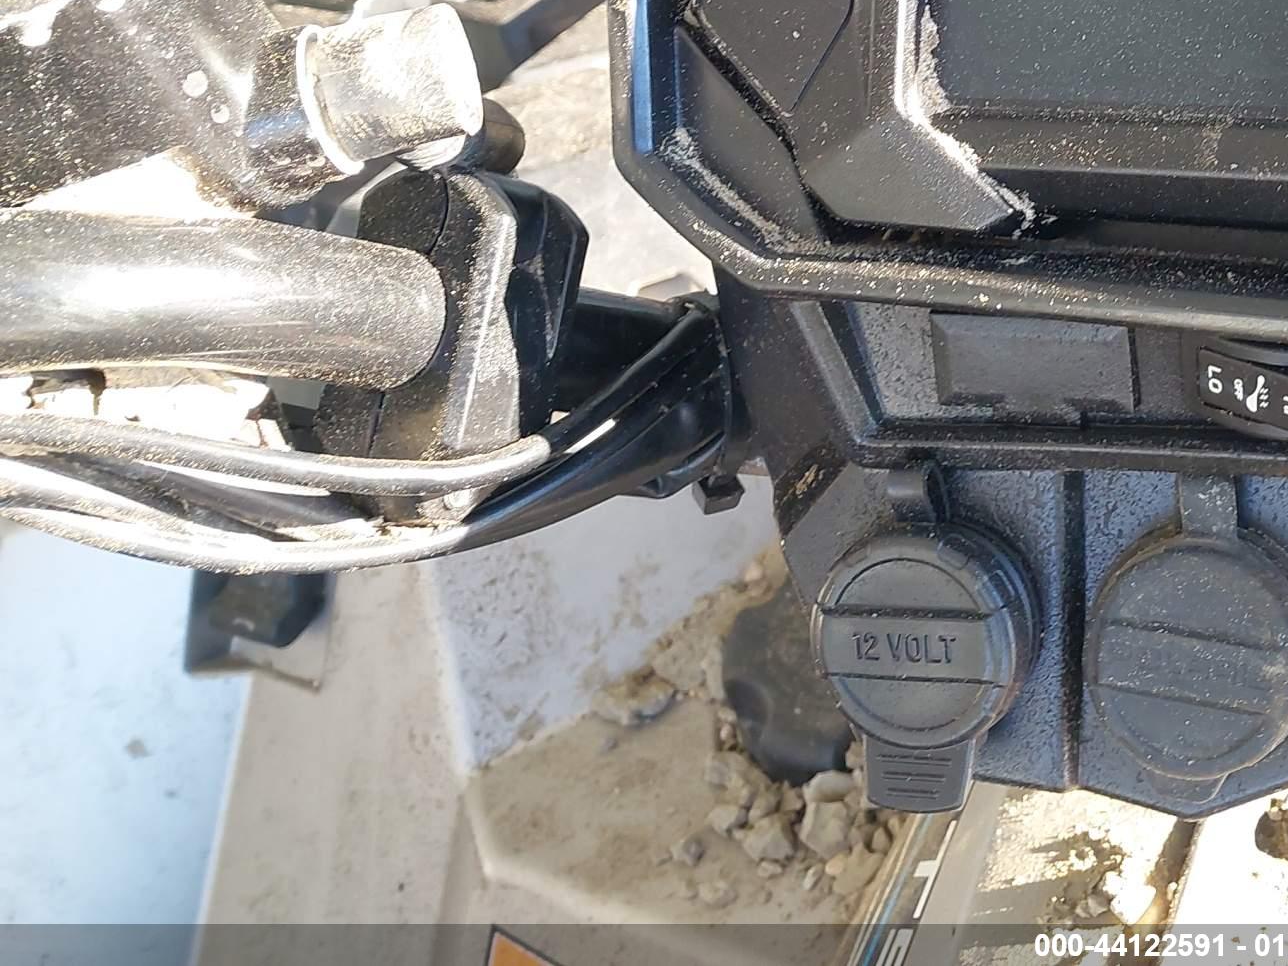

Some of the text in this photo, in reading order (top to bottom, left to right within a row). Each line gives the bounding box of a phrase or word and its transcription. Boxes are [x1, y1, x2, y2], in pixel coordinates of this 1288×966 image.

[1207, 364, 1223, 394] LO
[851, 631, 957, 664] 12 VOLT
